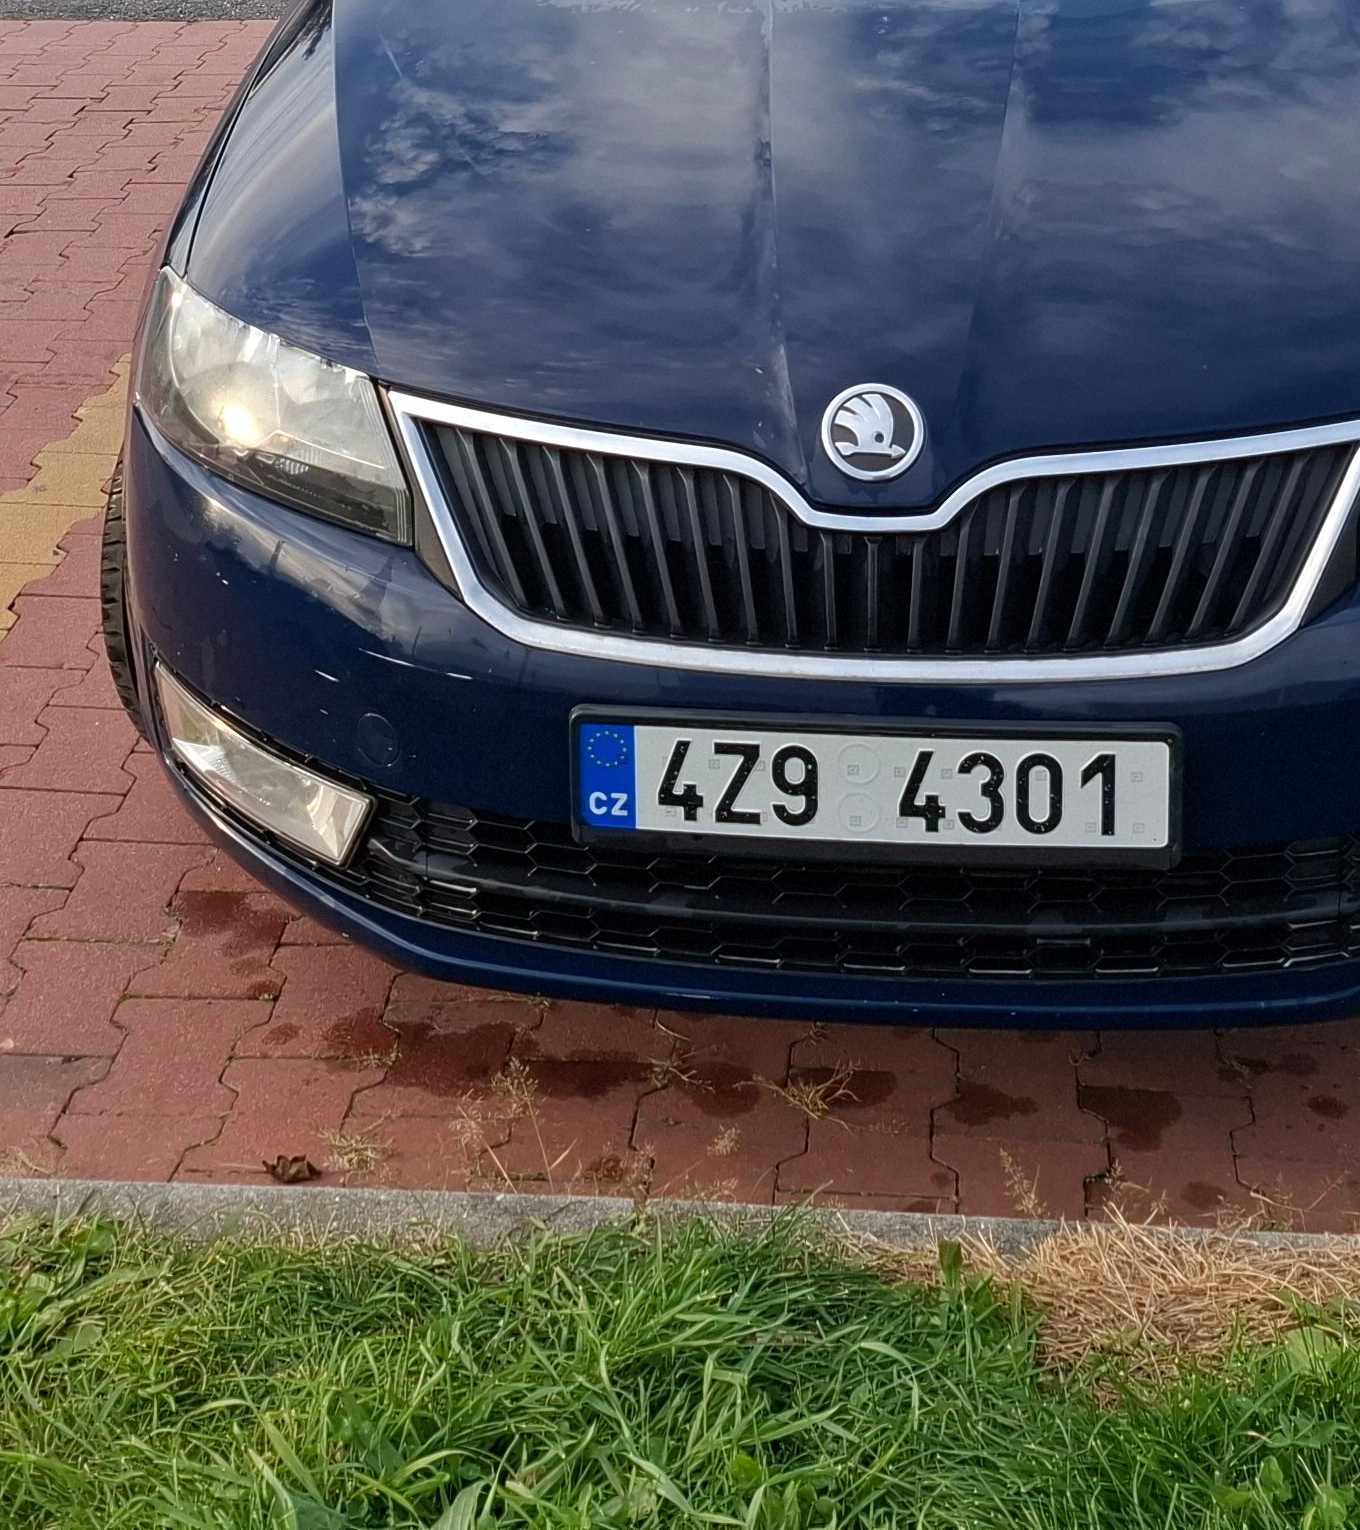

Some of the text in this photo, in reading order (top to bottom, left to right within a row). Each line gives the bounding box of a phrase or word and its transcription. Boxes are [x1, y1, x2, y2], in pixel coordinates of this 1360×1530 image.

[588, 738, 1117, 838] CZ 4Z9 4301
